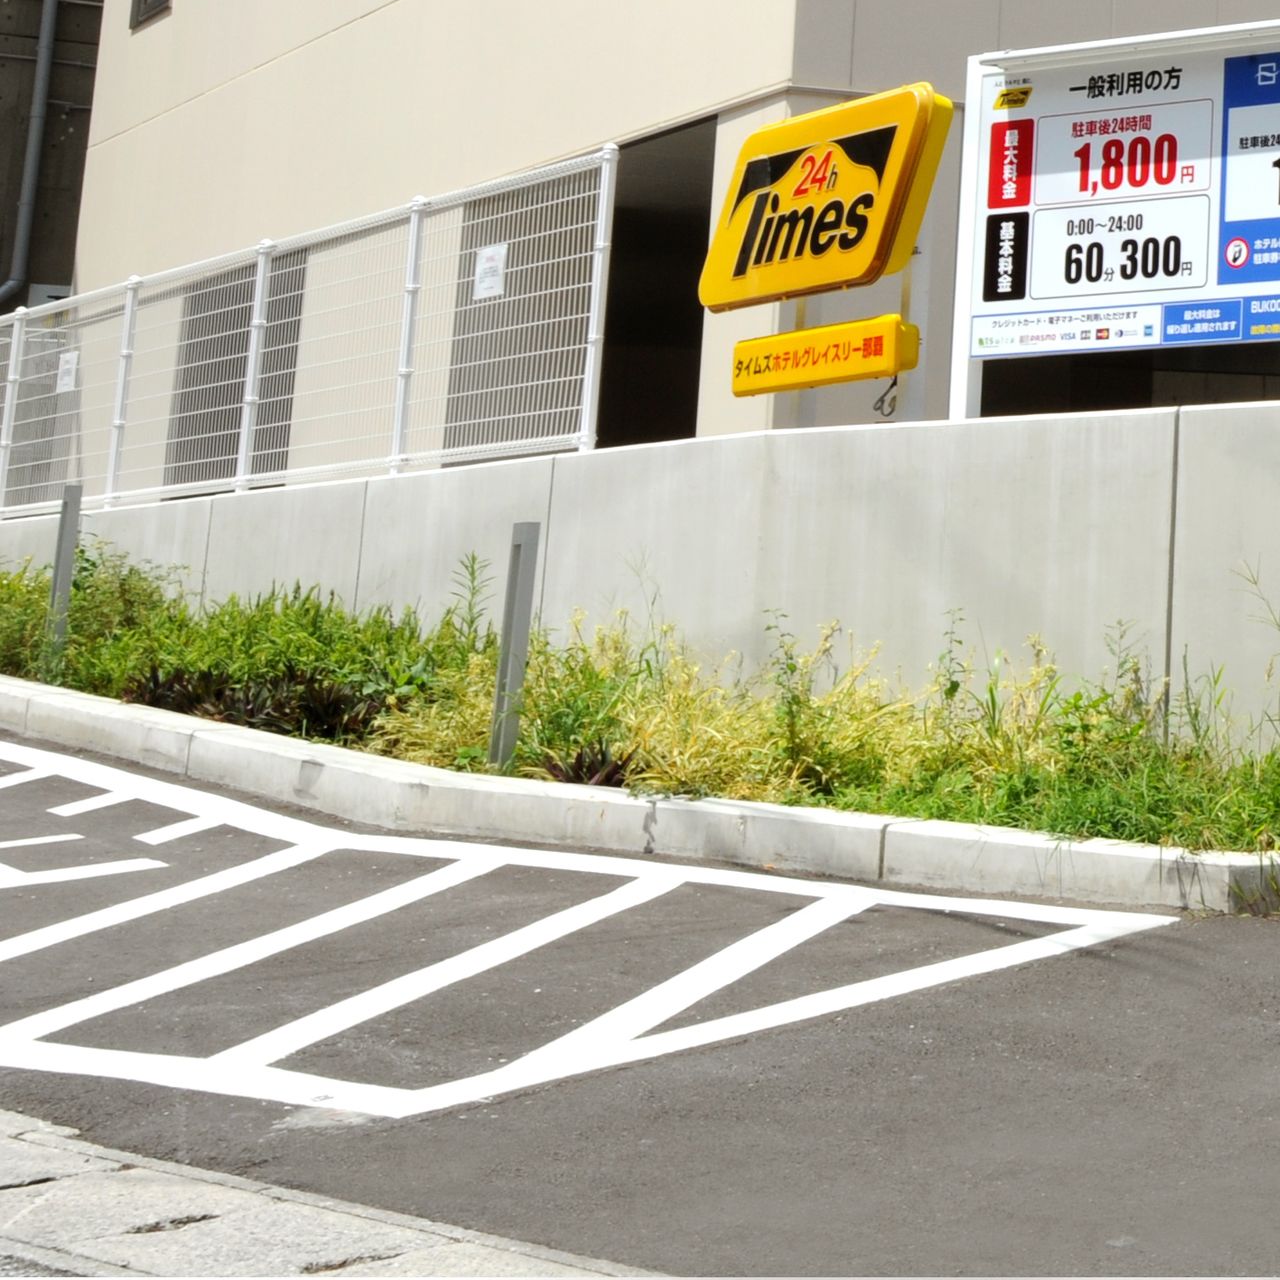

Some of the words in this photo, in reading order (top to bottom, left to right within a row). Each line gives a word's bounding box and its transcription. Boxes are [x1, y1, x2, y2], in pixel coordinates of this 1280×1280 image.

[1069, 67, 1183, 99] 一般利用の方
[1072, 115, 1152, 138] 駐車後24時間
[793, 150, 837, 197] 24h
[1002, 129, 1018, 199] 最大料金
[1074, 133, 1195, 197] 1,800円
[732, 191, 875, 280] Times
[997, 221, 1015, 293] 基本料金
[734, 335, 884, 379] タイムズホテルグレイスリー那覇
